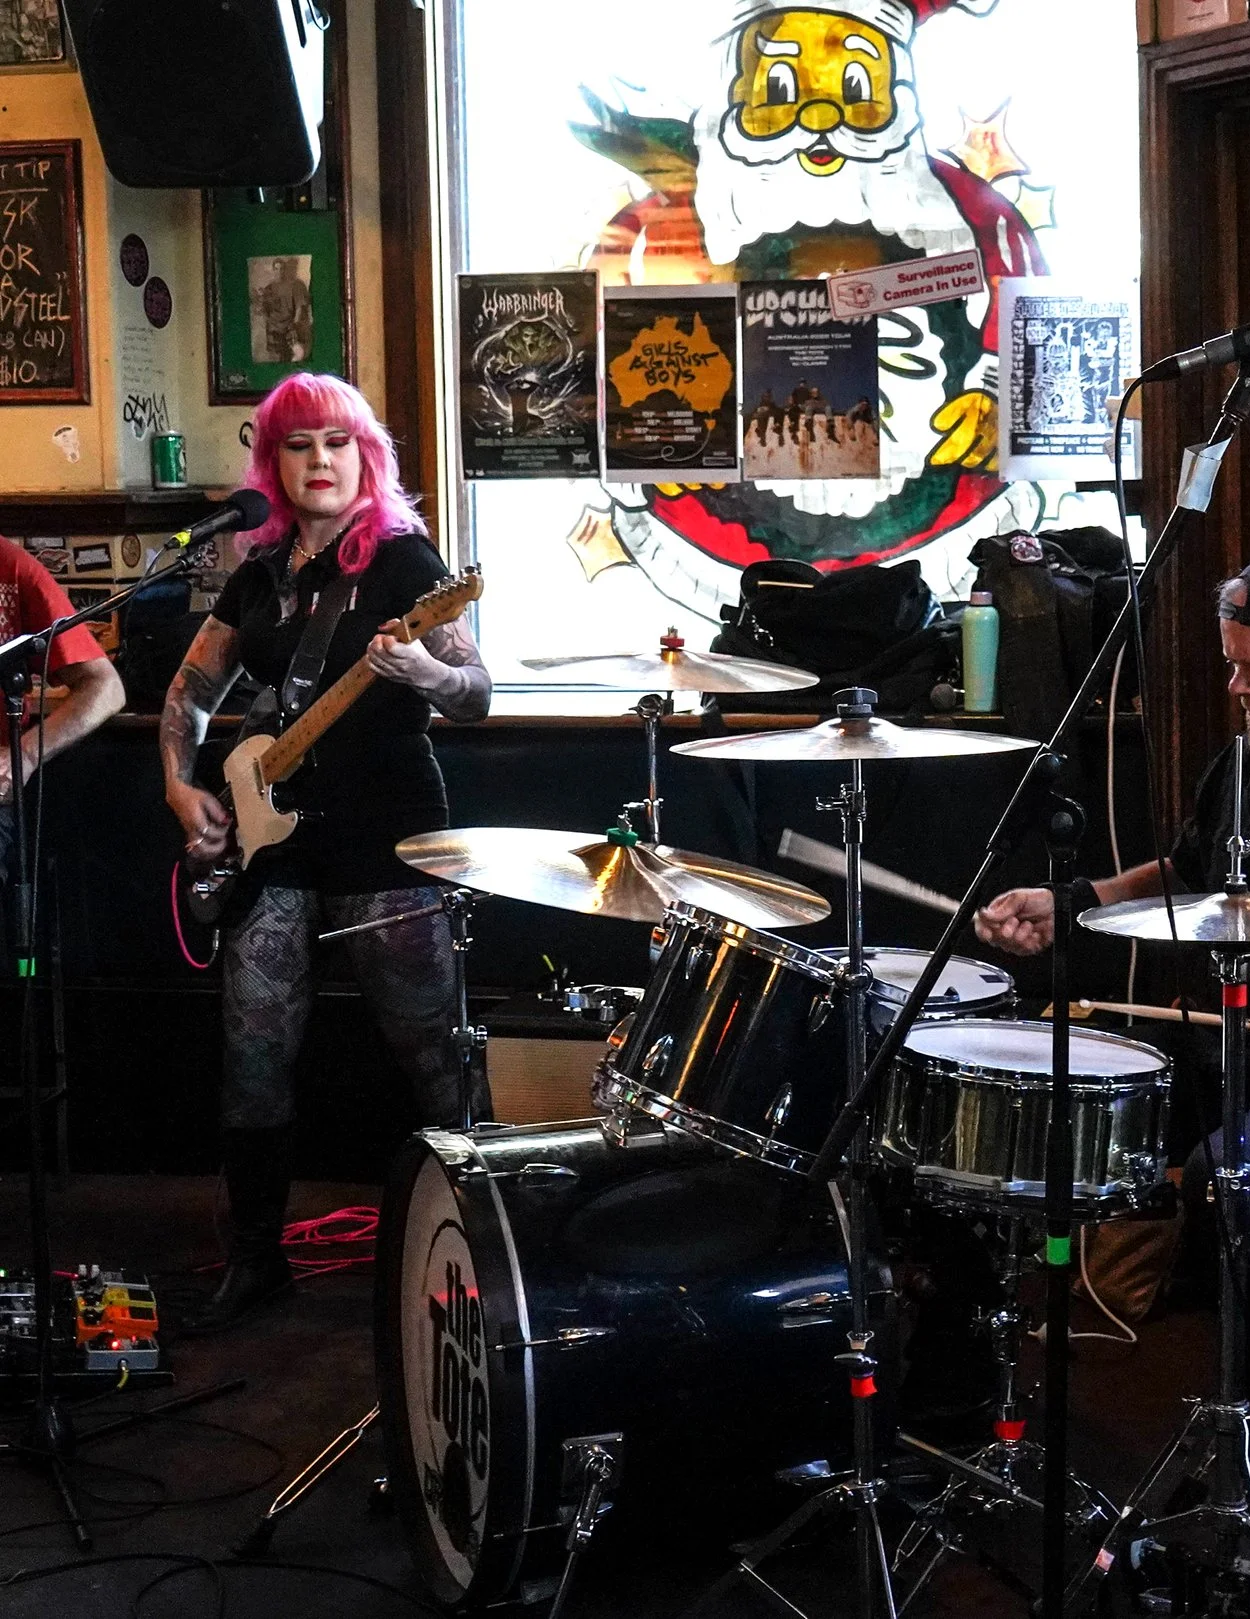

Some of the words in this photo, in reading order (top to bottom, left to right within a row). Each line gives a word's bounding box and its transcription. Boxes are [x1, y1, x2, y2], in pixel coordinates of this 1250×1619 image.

[16, 161, 50, 180] TIP
[897, 260, 975, 284] Surveillance
[883, 284, 933, 301] Camera
[935, 282, 948, 292] In
[952, 274, 978, 289] Use
[642, 341, 689, 356] GIRLS
[644, 369, 697, 387] BOYS
[446, 1261, 480, 1368] the
